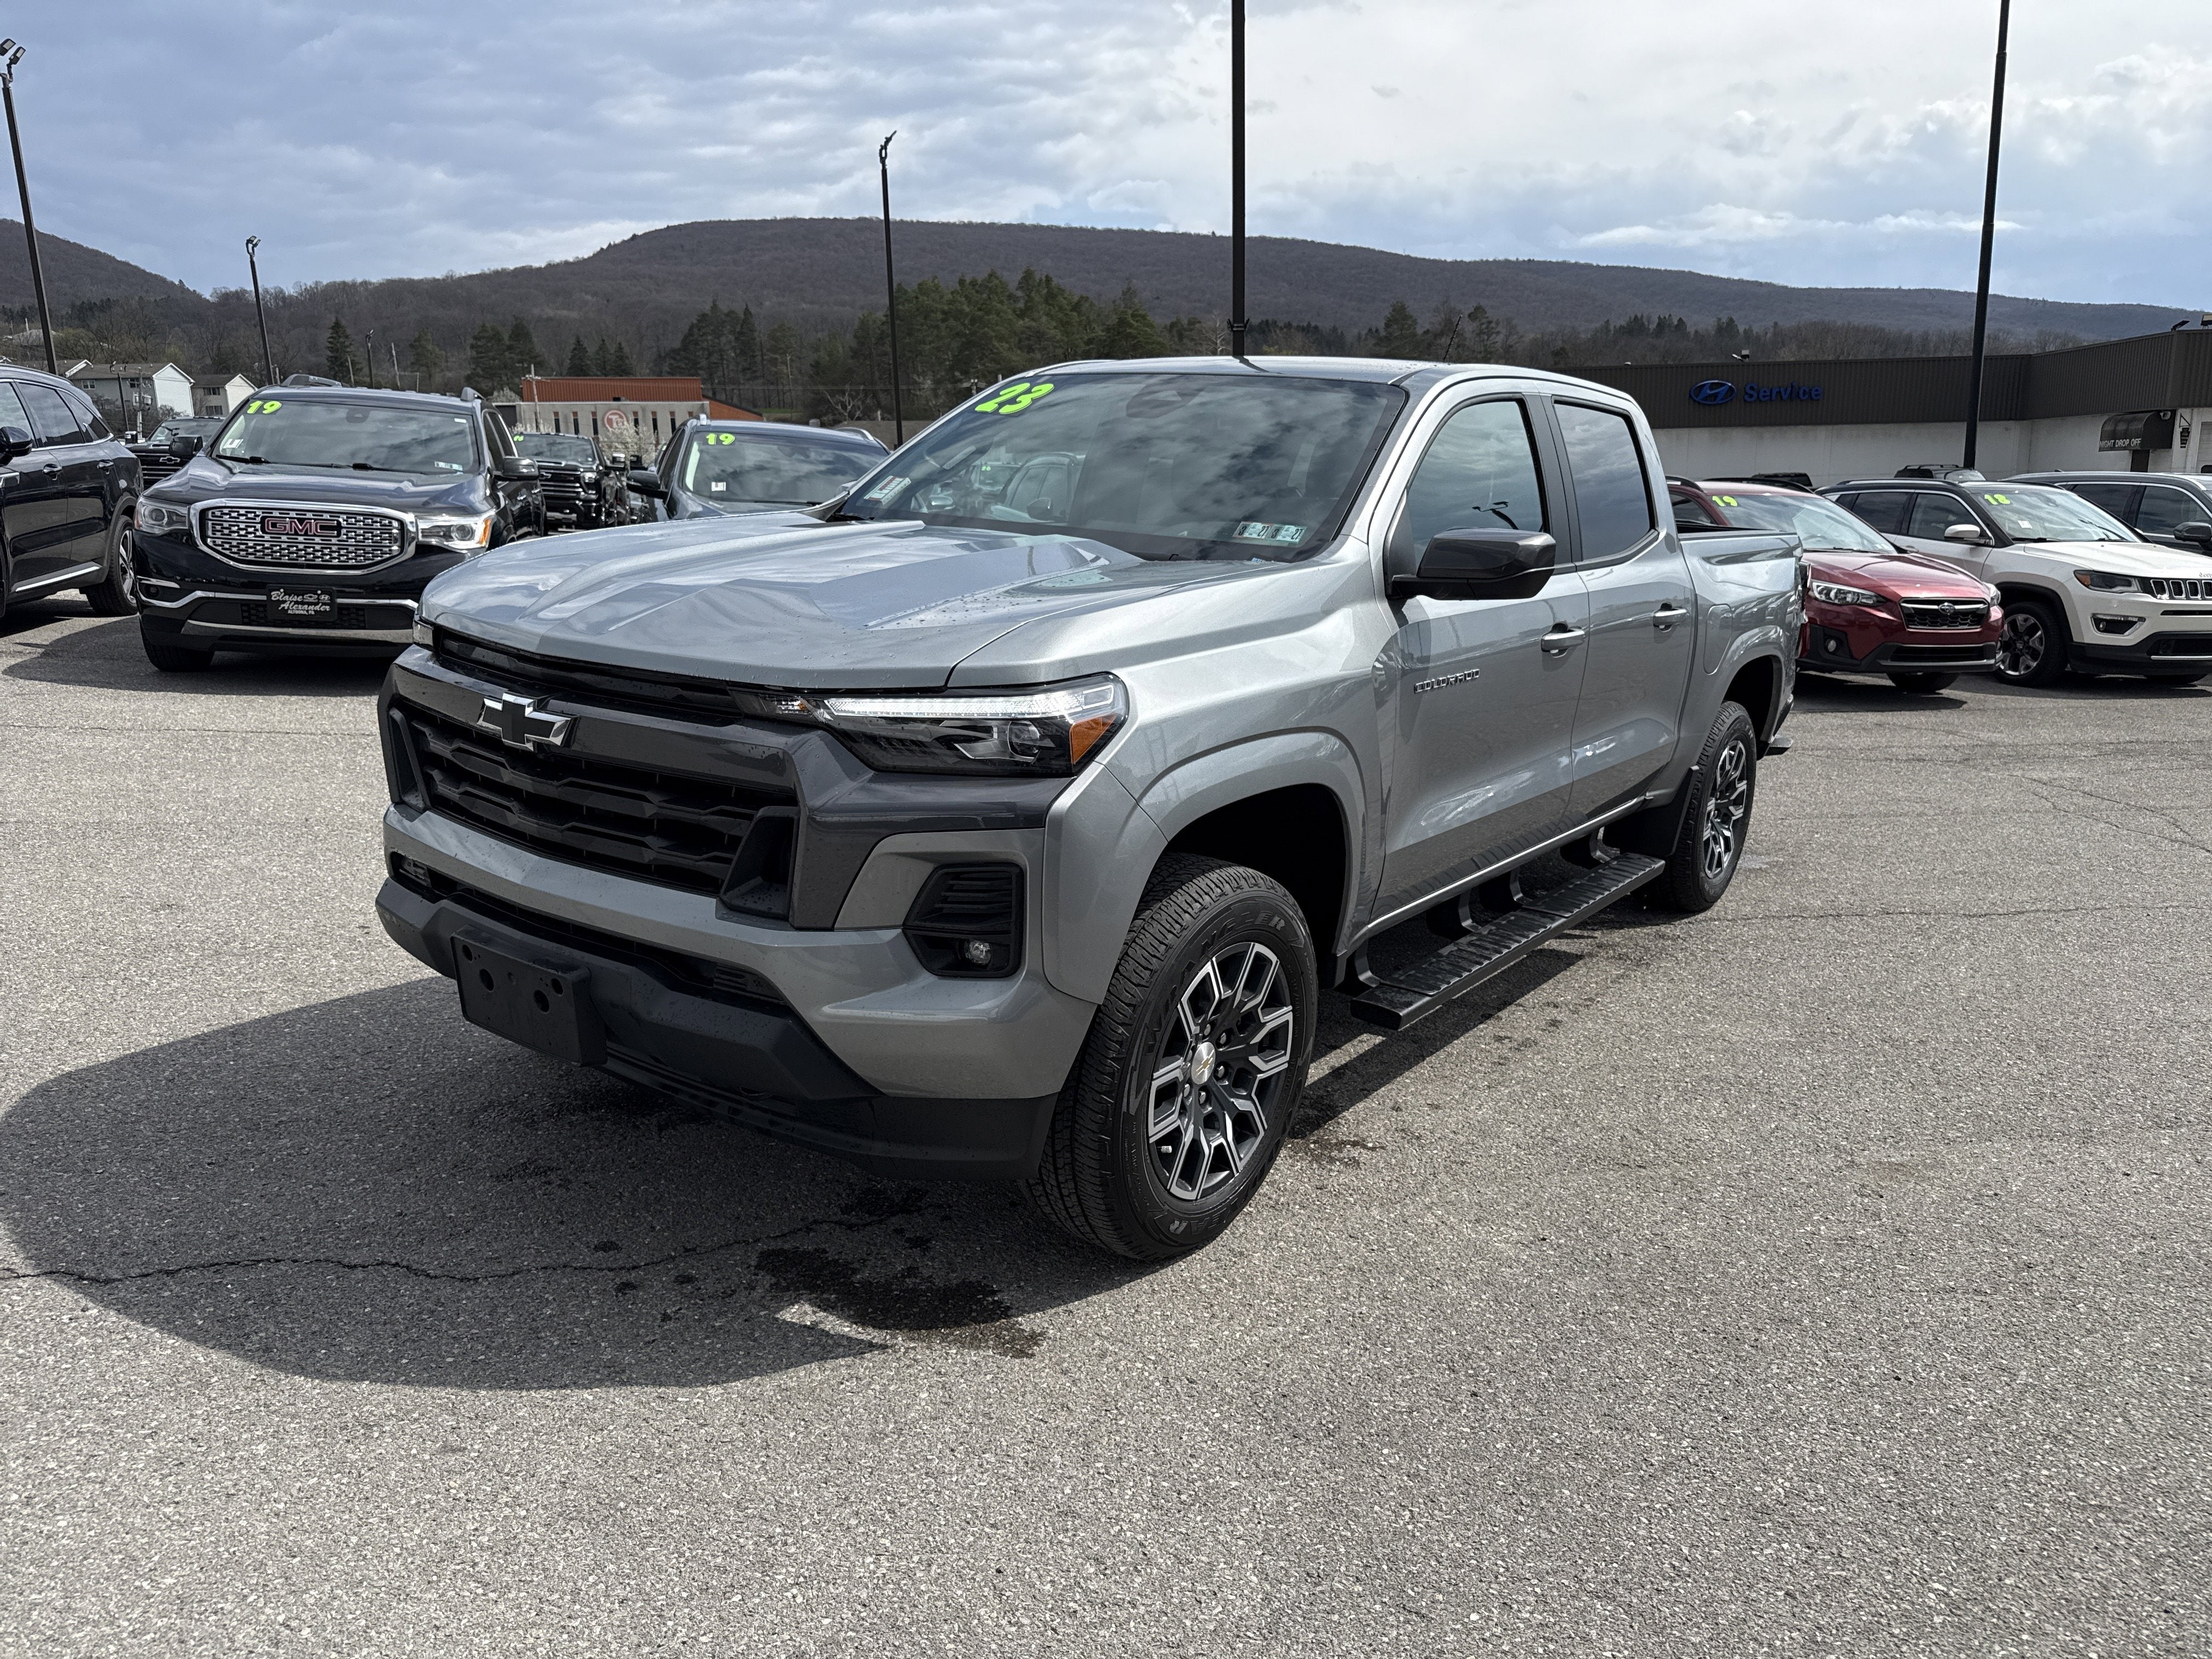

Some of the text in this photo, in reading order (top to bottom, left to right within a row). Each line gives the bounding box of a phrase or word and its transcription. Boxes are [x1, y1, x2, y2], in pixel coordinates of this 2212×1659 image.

[975, 382, 1055, 414] 23
[1743, 382, 1822, 402] Service
[247, 400, 282, 414] 19
[706, 433, 735, 445] 19
[2099, 438, 2142, 448] NIGHT DROP OFF
[1712, 495, 1737, 507] 19
[1984, 494, 2011, 505] 18
[265, 518, 337, 536] GMC
[1257, 526, 1270, 538] 27
[1291, 528, 1304, 540] 27
[270, 591, 303, 601] Blaise
[278, 601, 331, 611] Alexander
[1414, 669, 1480, 694] COLORADO
